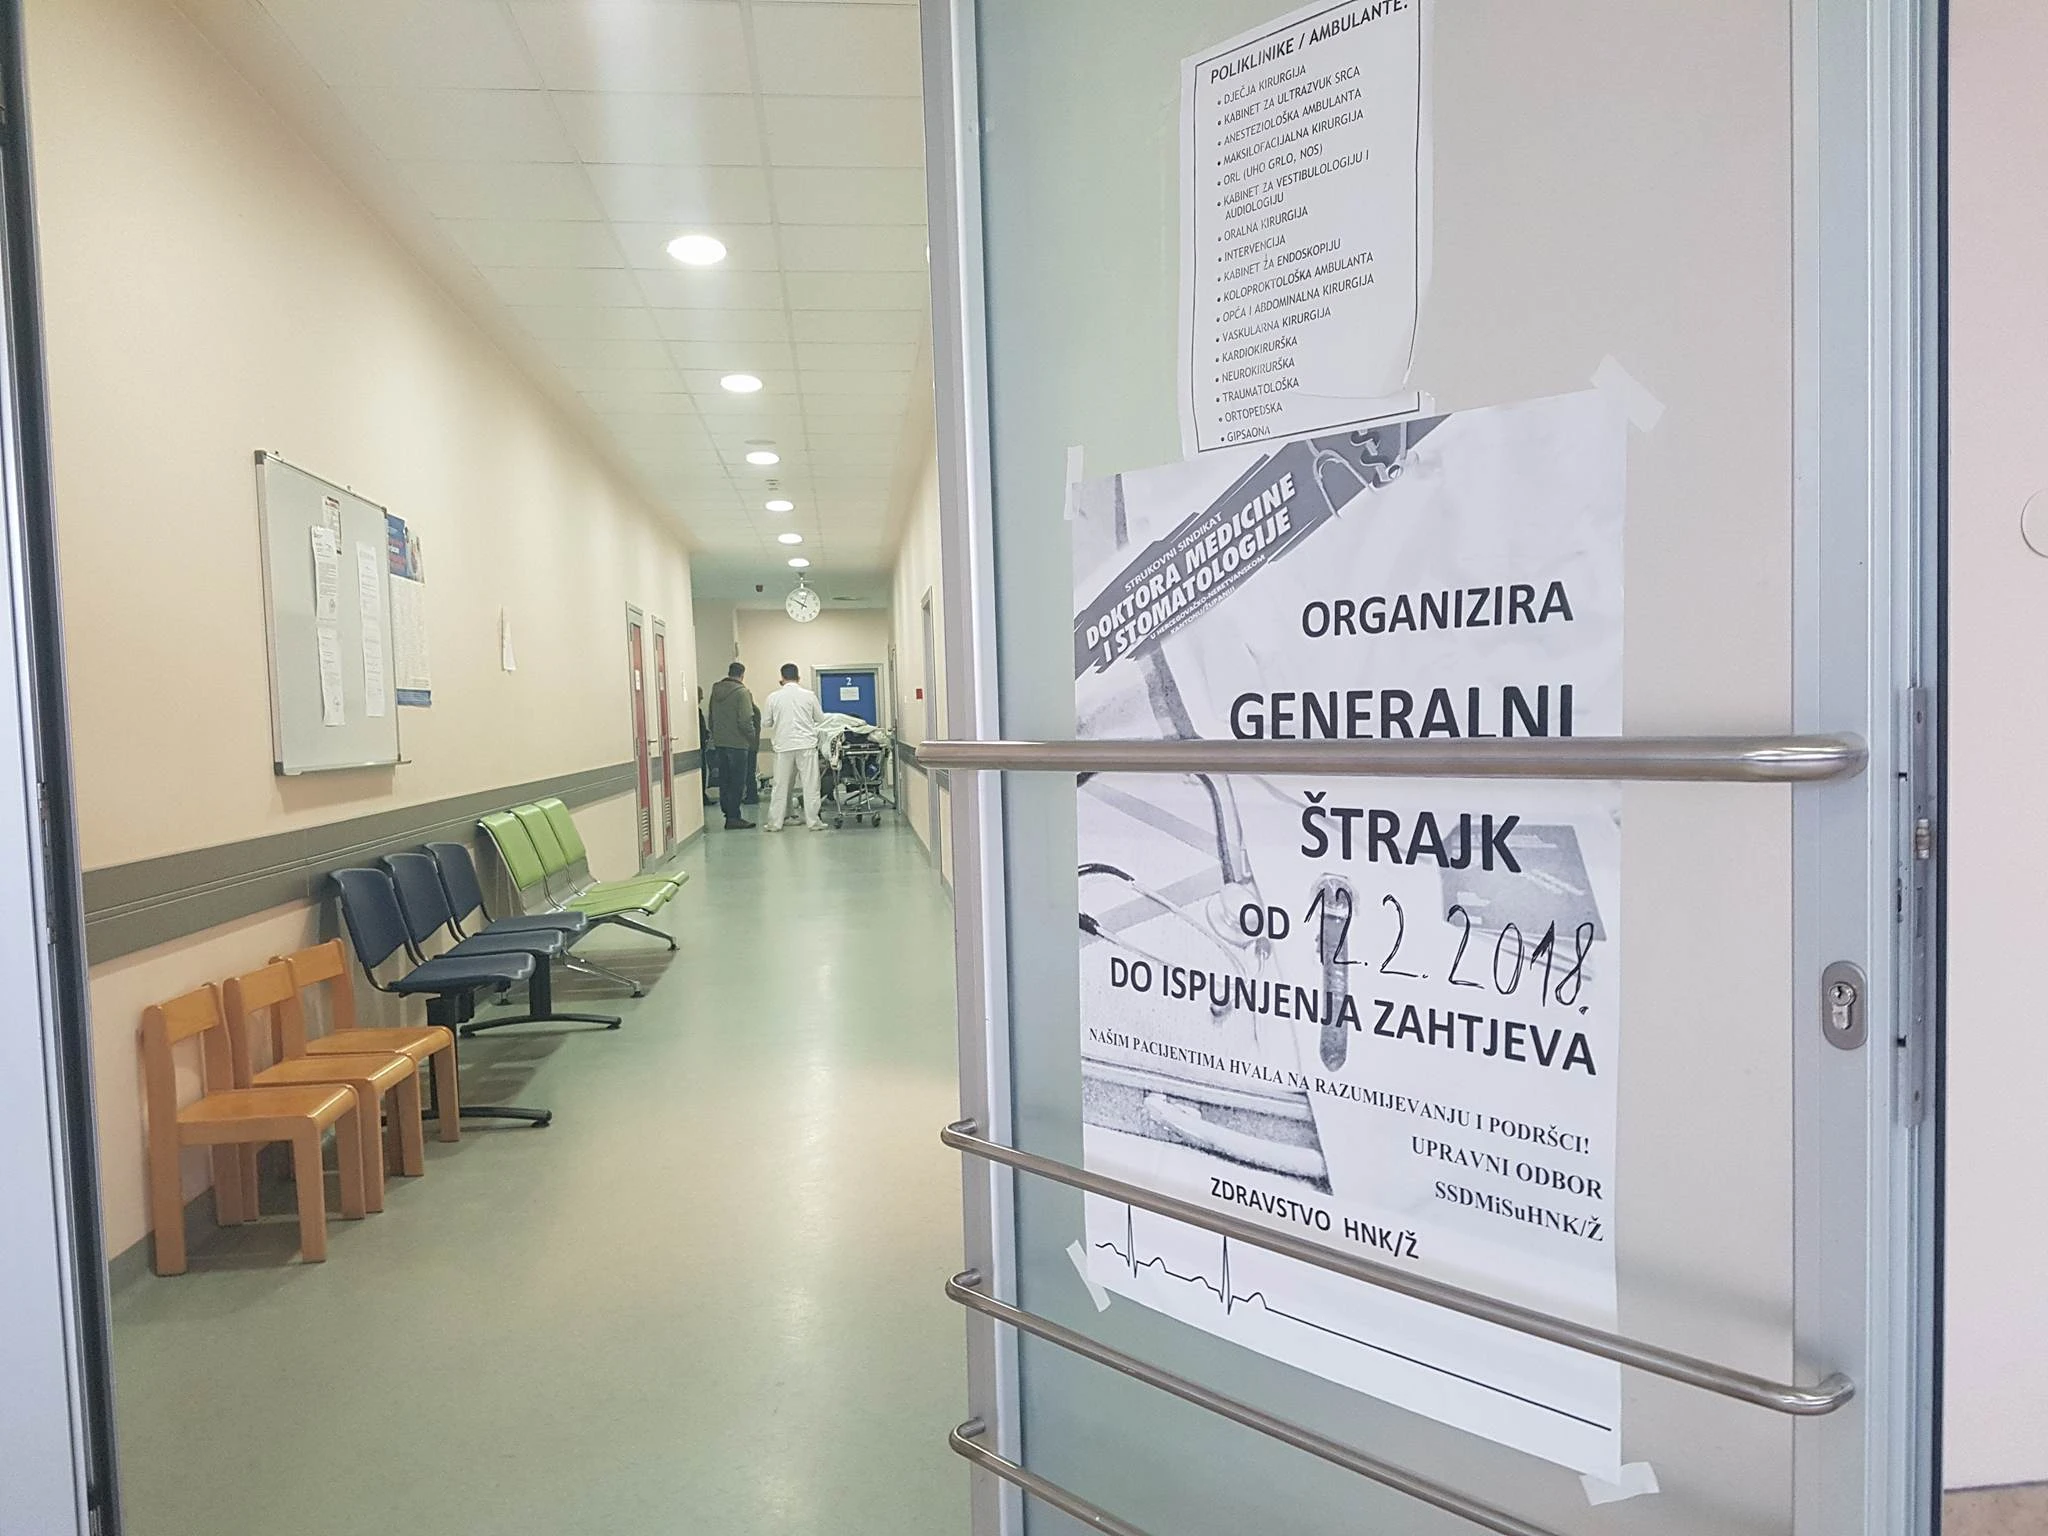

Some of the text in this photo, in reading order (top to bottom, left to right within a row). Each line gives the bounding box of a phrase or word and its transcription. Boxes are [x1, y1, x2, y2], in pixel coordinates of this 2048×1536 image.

[1210, 37, 1295, 84] POLIKLINIKE
[1298, 33, 1306, 50] /
[1223, 65, 1307, 105] DJEČJA KIRURGIJA
[1223, 66, 1361, 126] KABINET ZA ULTRAZVUK SRCA
[1223, 88, 1362, 146] ANESTEZIOLOŠKA AMBULANTA
[1223, 109, 1364, 166] MAKSILOFACIJALNA KIRURGIJA
[1223, 143, 1323, 186] ORL (UHO GRLO, NOS)
[1223, 185, 1260, 207] KABINET
[1263, 182, 1274, 193] ZA
[1276, 151, 1363, 188] VESTIBULOLOGIJU
[1223, 205, 1309, 241] ORALNA KIRURGIJA
[1225, 192, 1285, 221] AUDIOLOGIJU
[1223, 235, 1286, 262] INTERVENCIJA
[1223, 262, 1261, 282] KABINET
[1276, 238, 1341, 267] ENDOSKOPIJU
[1222, 306, 1247, 322] OPĆA
[1254, 287, 1320, 315] ABDOMINALNA
[1322, 273, 1375, 297] KIRURGIJA
[1223, 251, 1374, 302] KOLOPROKTOLOŠKA AMBULANTA
[1221, 335, 1298, 363] KARDIOKIRURŠKA
[1222, 307, 1331, 343] VASKULARNA KIRURGIJA
[1221, 357, 1296, 383] NEUROKIRURŠKA
[1222, 377, 1300, 402] TRAUMATOLOŠKA
[1224, 401, 1283, 422] ORTOPEDSKA
[1226, 426, 1271, 442] GIPSAONA
[1085, 471, 1296, 650] DOKTORA MEDICINE
[1124, 511, 1223, 592] STRUKOVNI SINDIKAT
[1102, 505, 1292, 663] I STOMATOLOGIJE
[1301, 581, 1574, 638] ORGANIZIRA
[845, 677, 852, 686] 2
[1230, 683, 1574, 740] GENERALNI
[1301, 790, 1522, 874] ŠTRAJK
[1238, 903, 1290, 940] OD
[1110, 956, 1597, 1076] DO ISPUNJENJA ZAHTJEVA
[1088, 1027, 1590, 1155] NAŠIM PACIJENTIMA HVALA NA RAZUMIJEVANJU I PODRŠCI!
[1411, 1135, 1604, 1200] UPRAVNI ODBOR
[1210, 1176, 1420, 1260] ZDRAVSTVO HNK/Ž
[1434, 1180, 1604, 1242] SSDMiSuHNK/Ž
